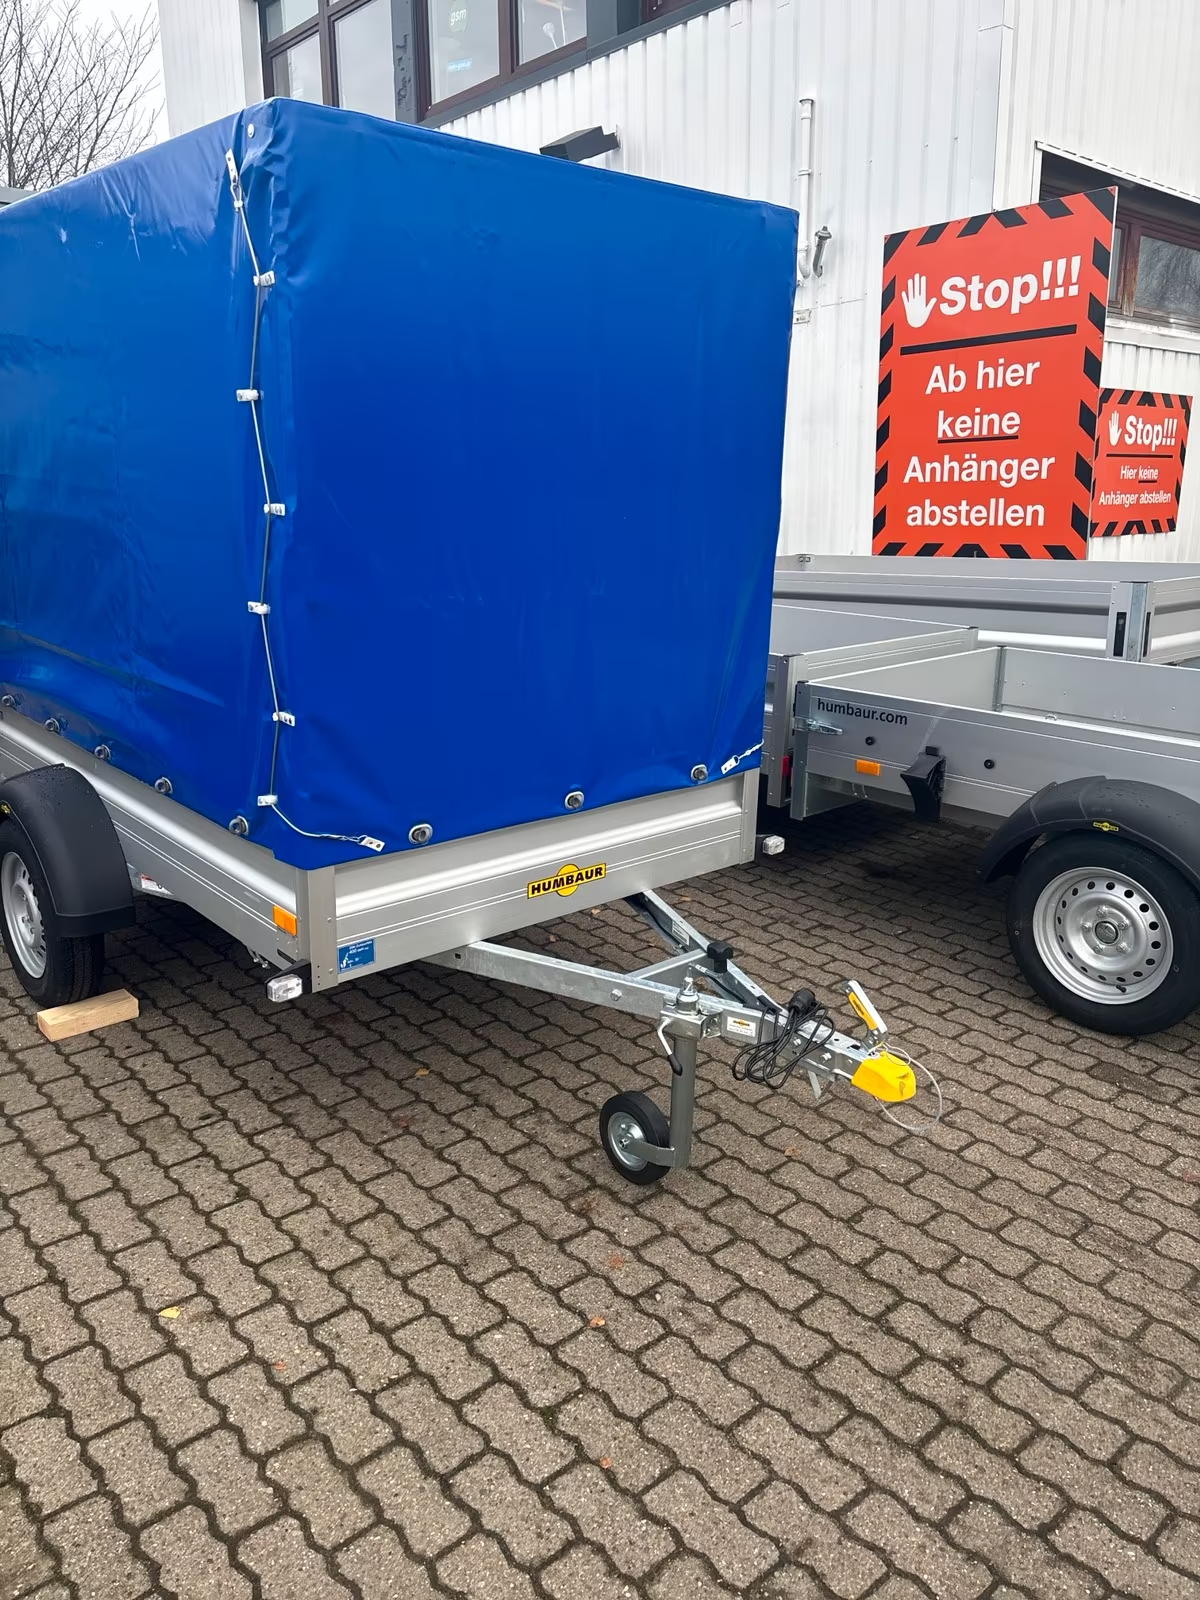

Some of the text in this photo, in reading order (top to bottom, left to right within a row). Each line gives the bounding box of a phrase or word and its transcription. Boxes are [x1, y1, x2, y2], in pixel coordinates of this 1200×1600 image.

[450, 9, 467, 26] gsm
[939, 255, 1081, 315] Stop!!!
[925, 358, 1040, 394] Ab hier
[937, 407, 1020, 438] keine
[1124, 415, 1178, 452] Stop!!!
[903, 453, 1055, 488] Anhänger
[1120, 465, 1159, 480] Hier keine
[906, 498, 1045, 526] abstellen
[1098, 490, 1172, 508] Anhänger abstellen
[817, 698, 908, 725] humbaur.com
[531, 867, 603, 895] HUMBAUR
